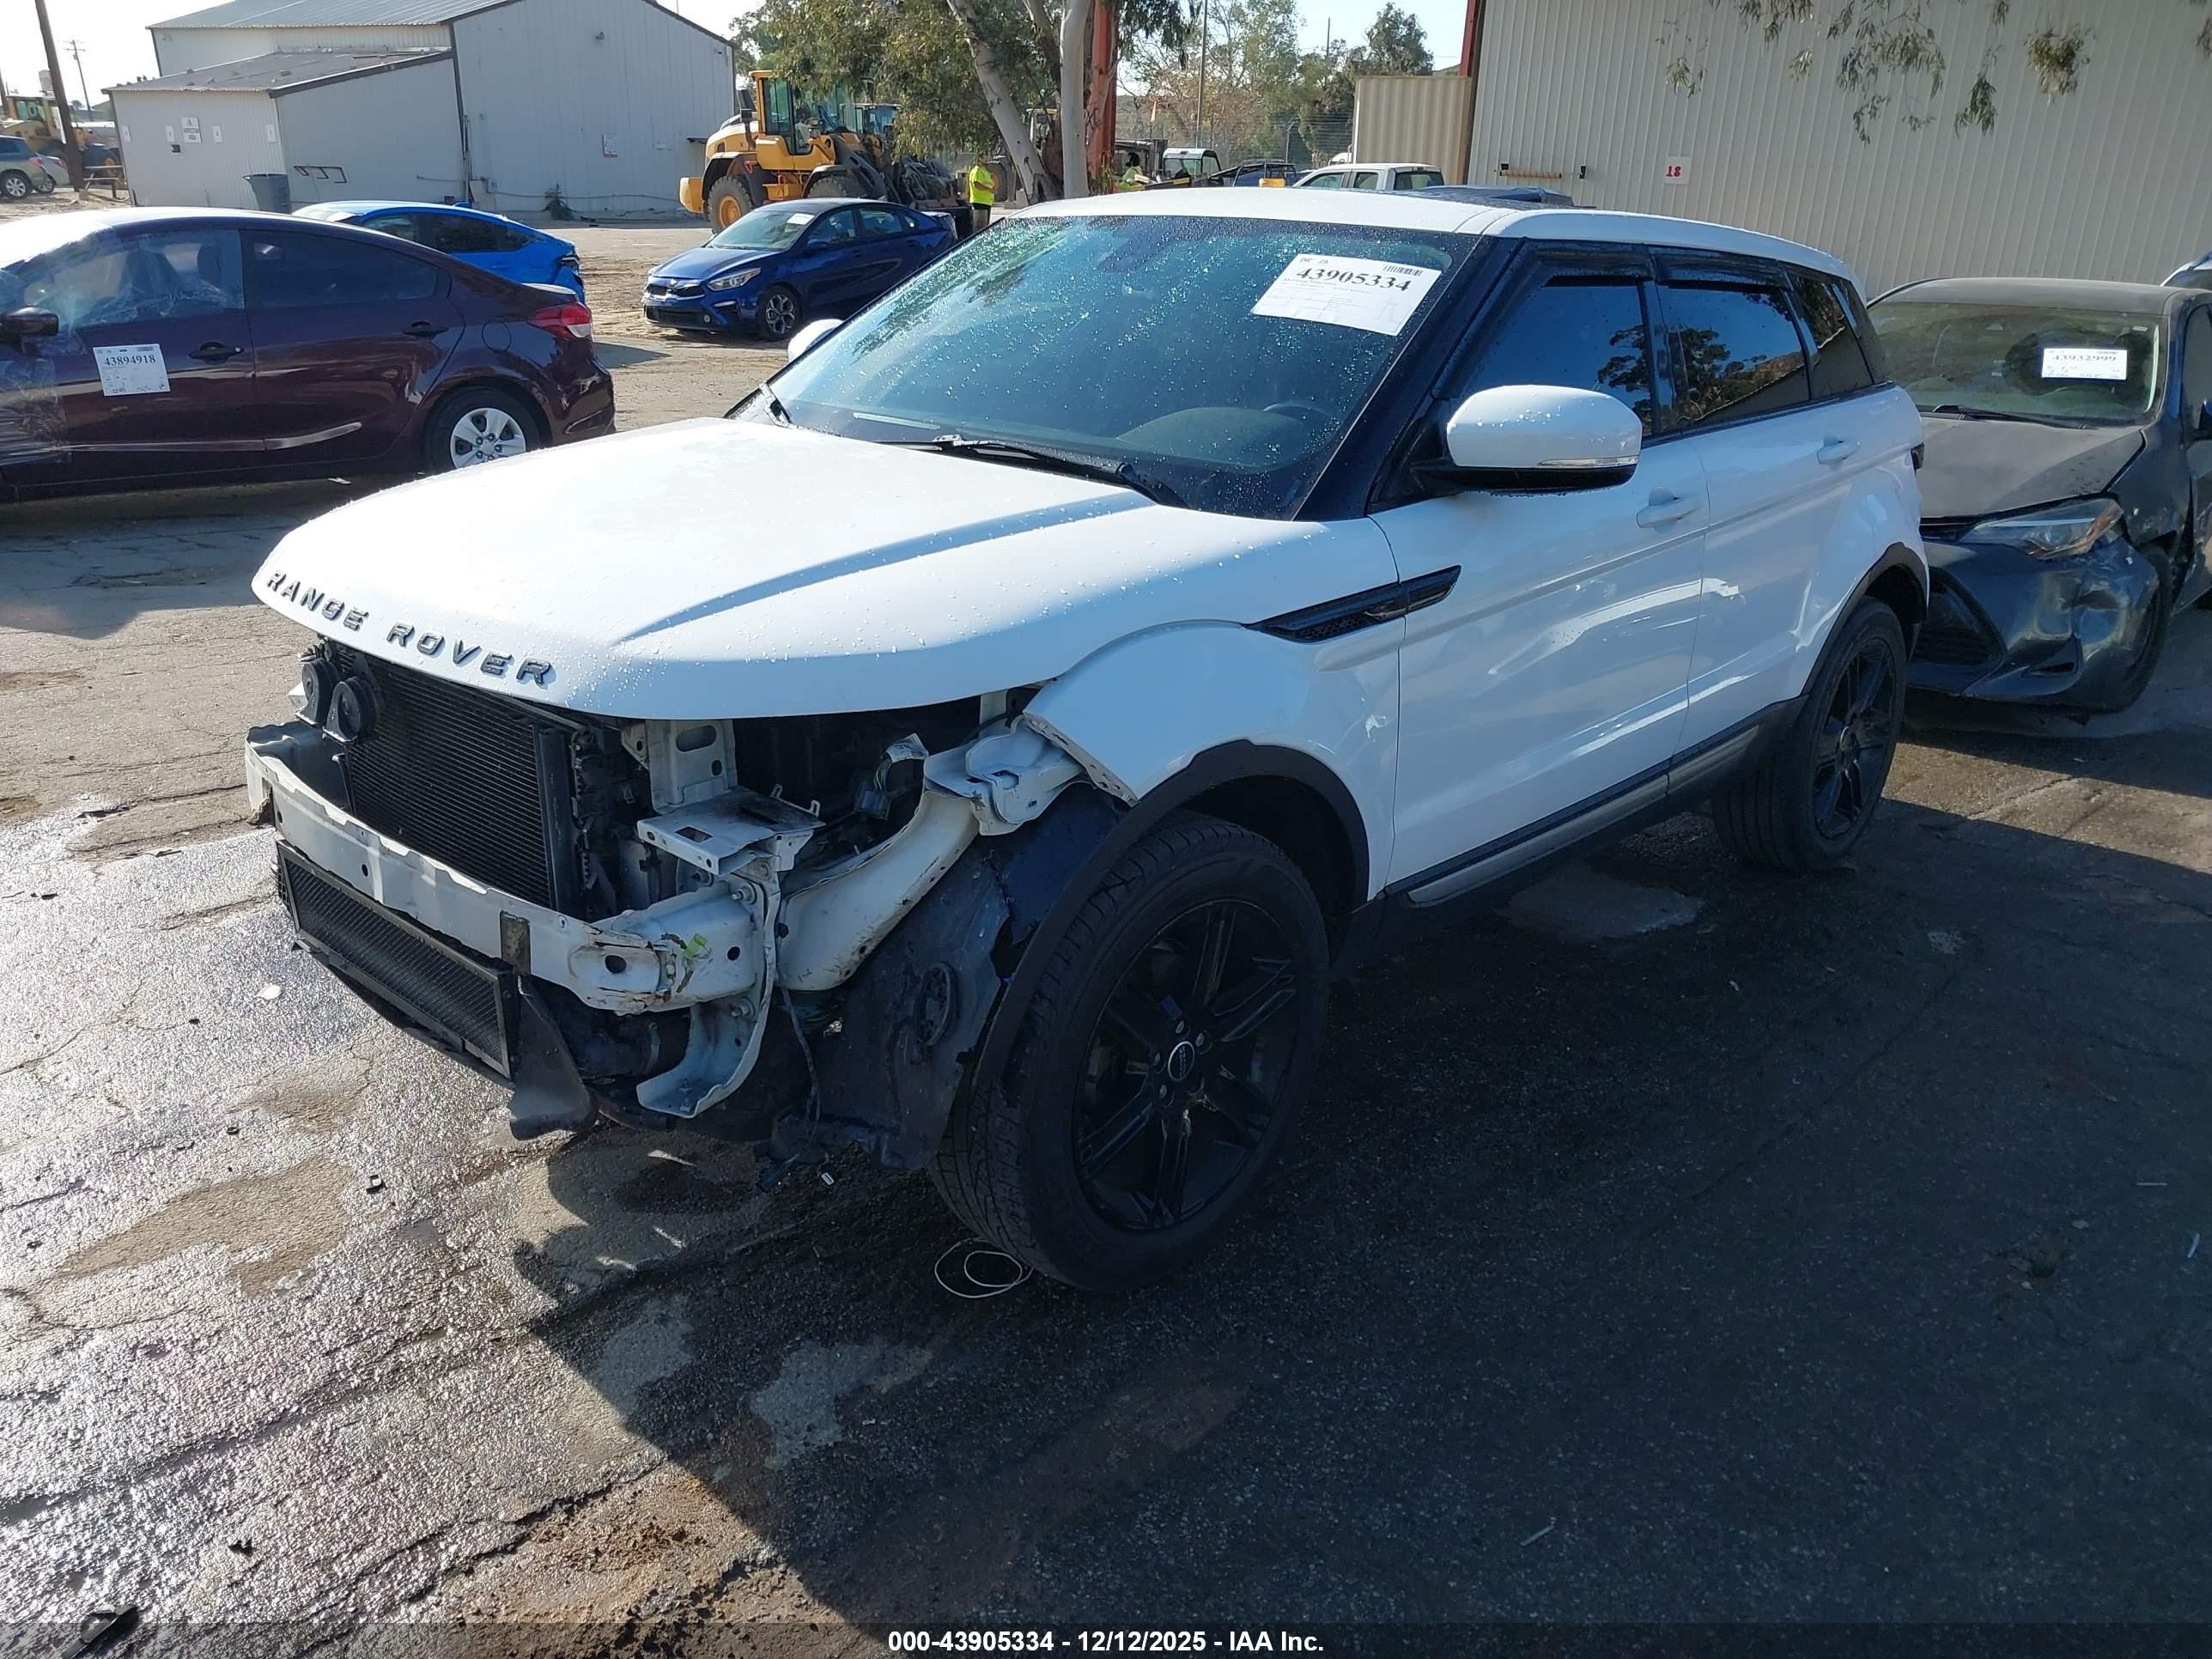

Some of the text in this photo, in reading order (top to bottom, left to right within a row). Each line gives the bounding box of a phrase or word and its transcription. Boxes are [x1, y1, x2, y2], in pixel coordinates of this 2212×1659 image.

[1665, 166, 1681, 177] 18
[1296, 267, 1412, 291] 43905334
[104, 354, 156, 366] 43894918
[266, 570, 552, 686] RANGE ROVER
